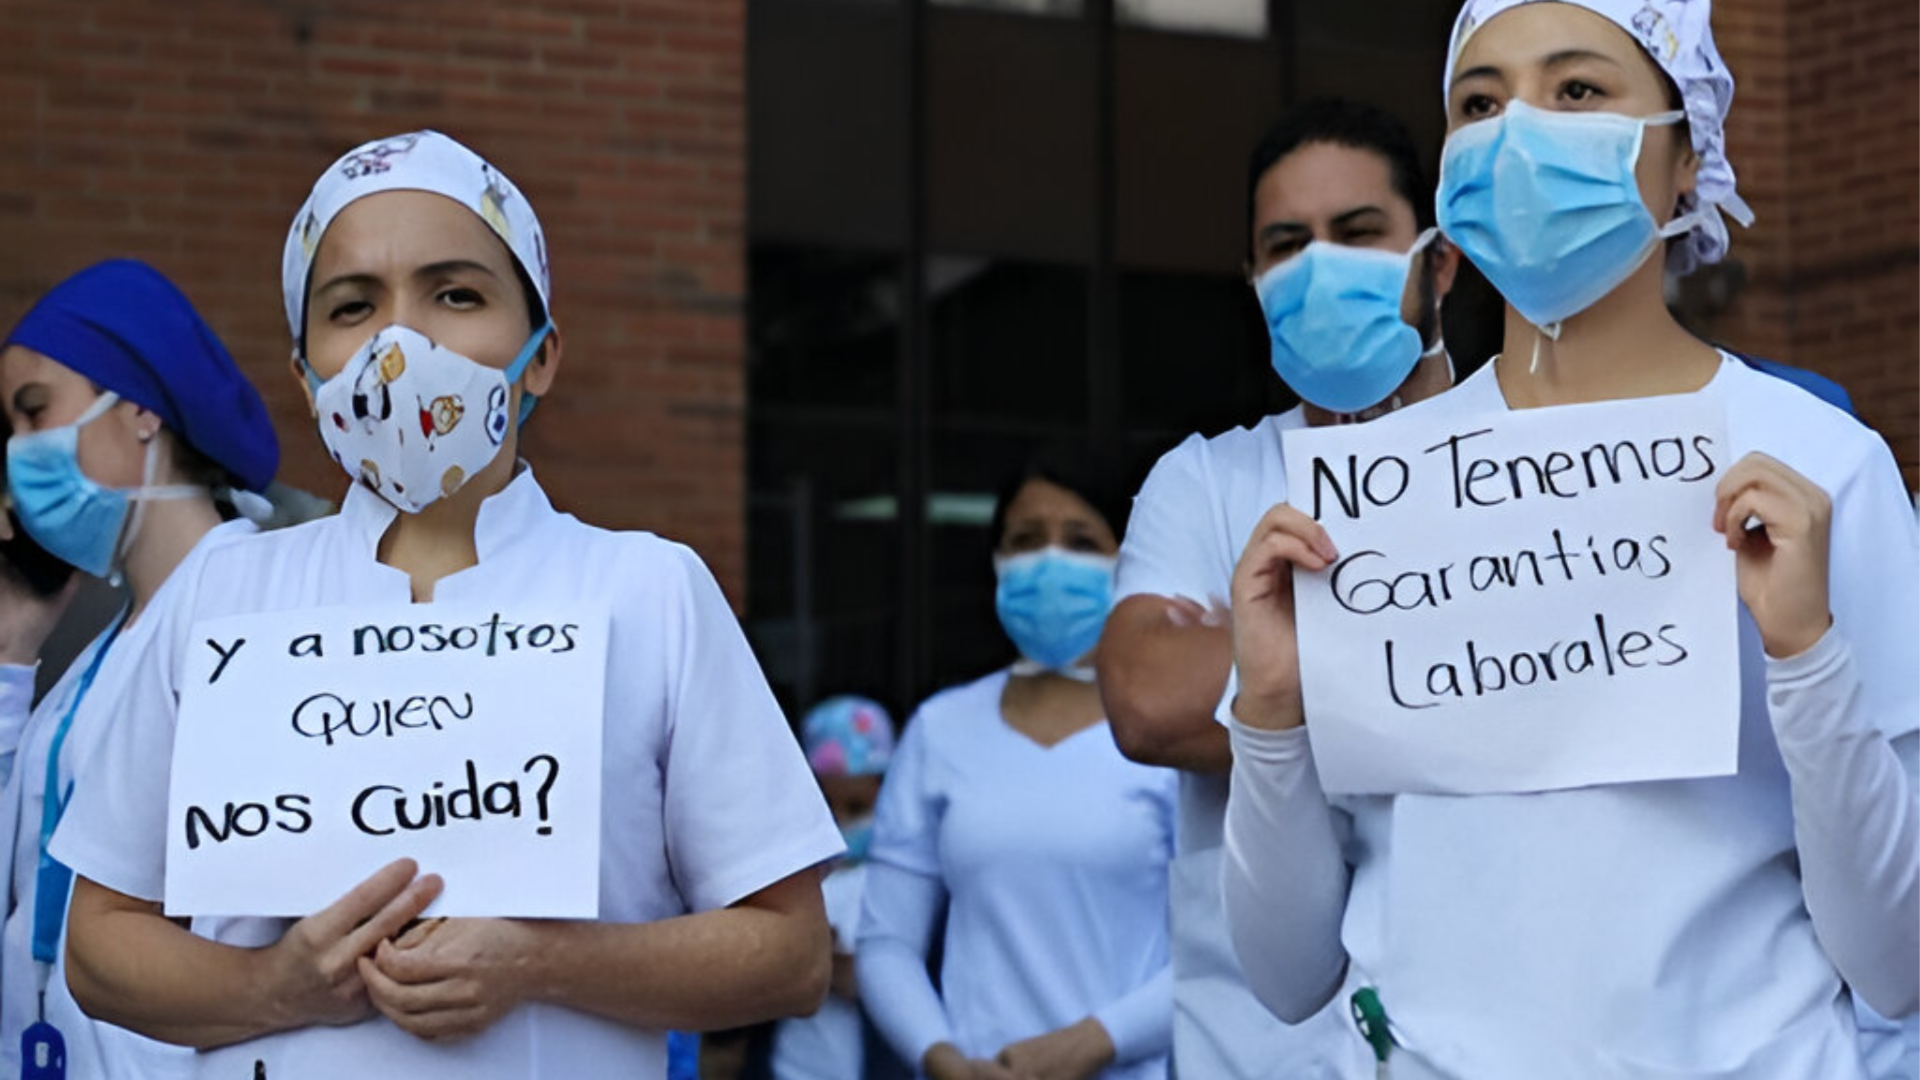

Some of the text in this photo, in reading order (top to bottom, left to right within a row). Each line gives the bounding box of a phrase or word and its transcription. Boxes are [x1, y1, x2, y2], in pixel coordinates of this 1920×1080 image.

[1311, 428, 1716, 522] NO Tenemos
[288, 633, 324, 657] a
[353, 612, 579, 656] nosotros
[1384, 613, 1689, 710] Laborales
[291, 692, 474, 746] QUIEN
[351, 754, 560, 836] Cuida?
